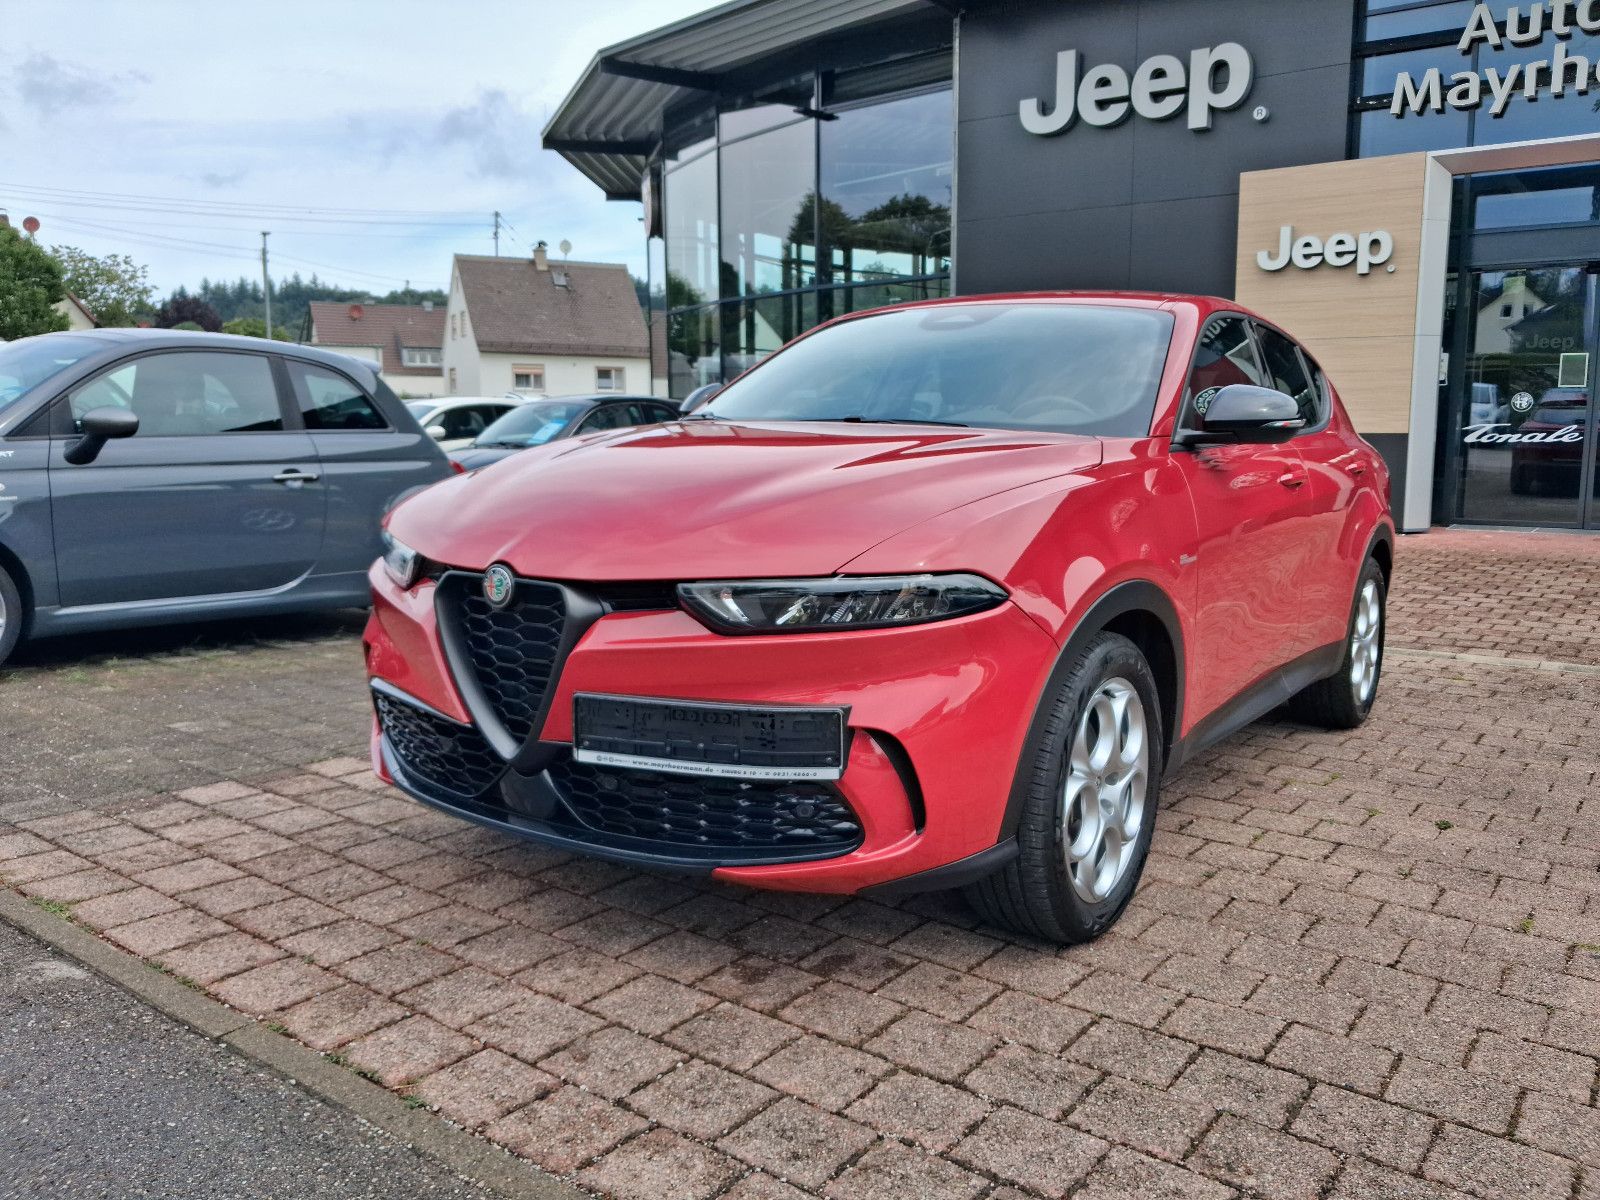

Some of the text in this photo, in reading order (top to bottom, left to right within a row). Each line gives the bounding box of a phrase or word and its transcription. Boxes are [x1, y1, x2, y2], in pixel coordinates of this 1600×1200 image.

[1019, 42, 1252, 135] Jeep
[1390, 43, 1600, 115] Mayrh
[1256, 224, 1394, 275] Jeep
[1525, 333, 1575, 351] Jeep
[1461, 422, 1584, 443] Tonale
